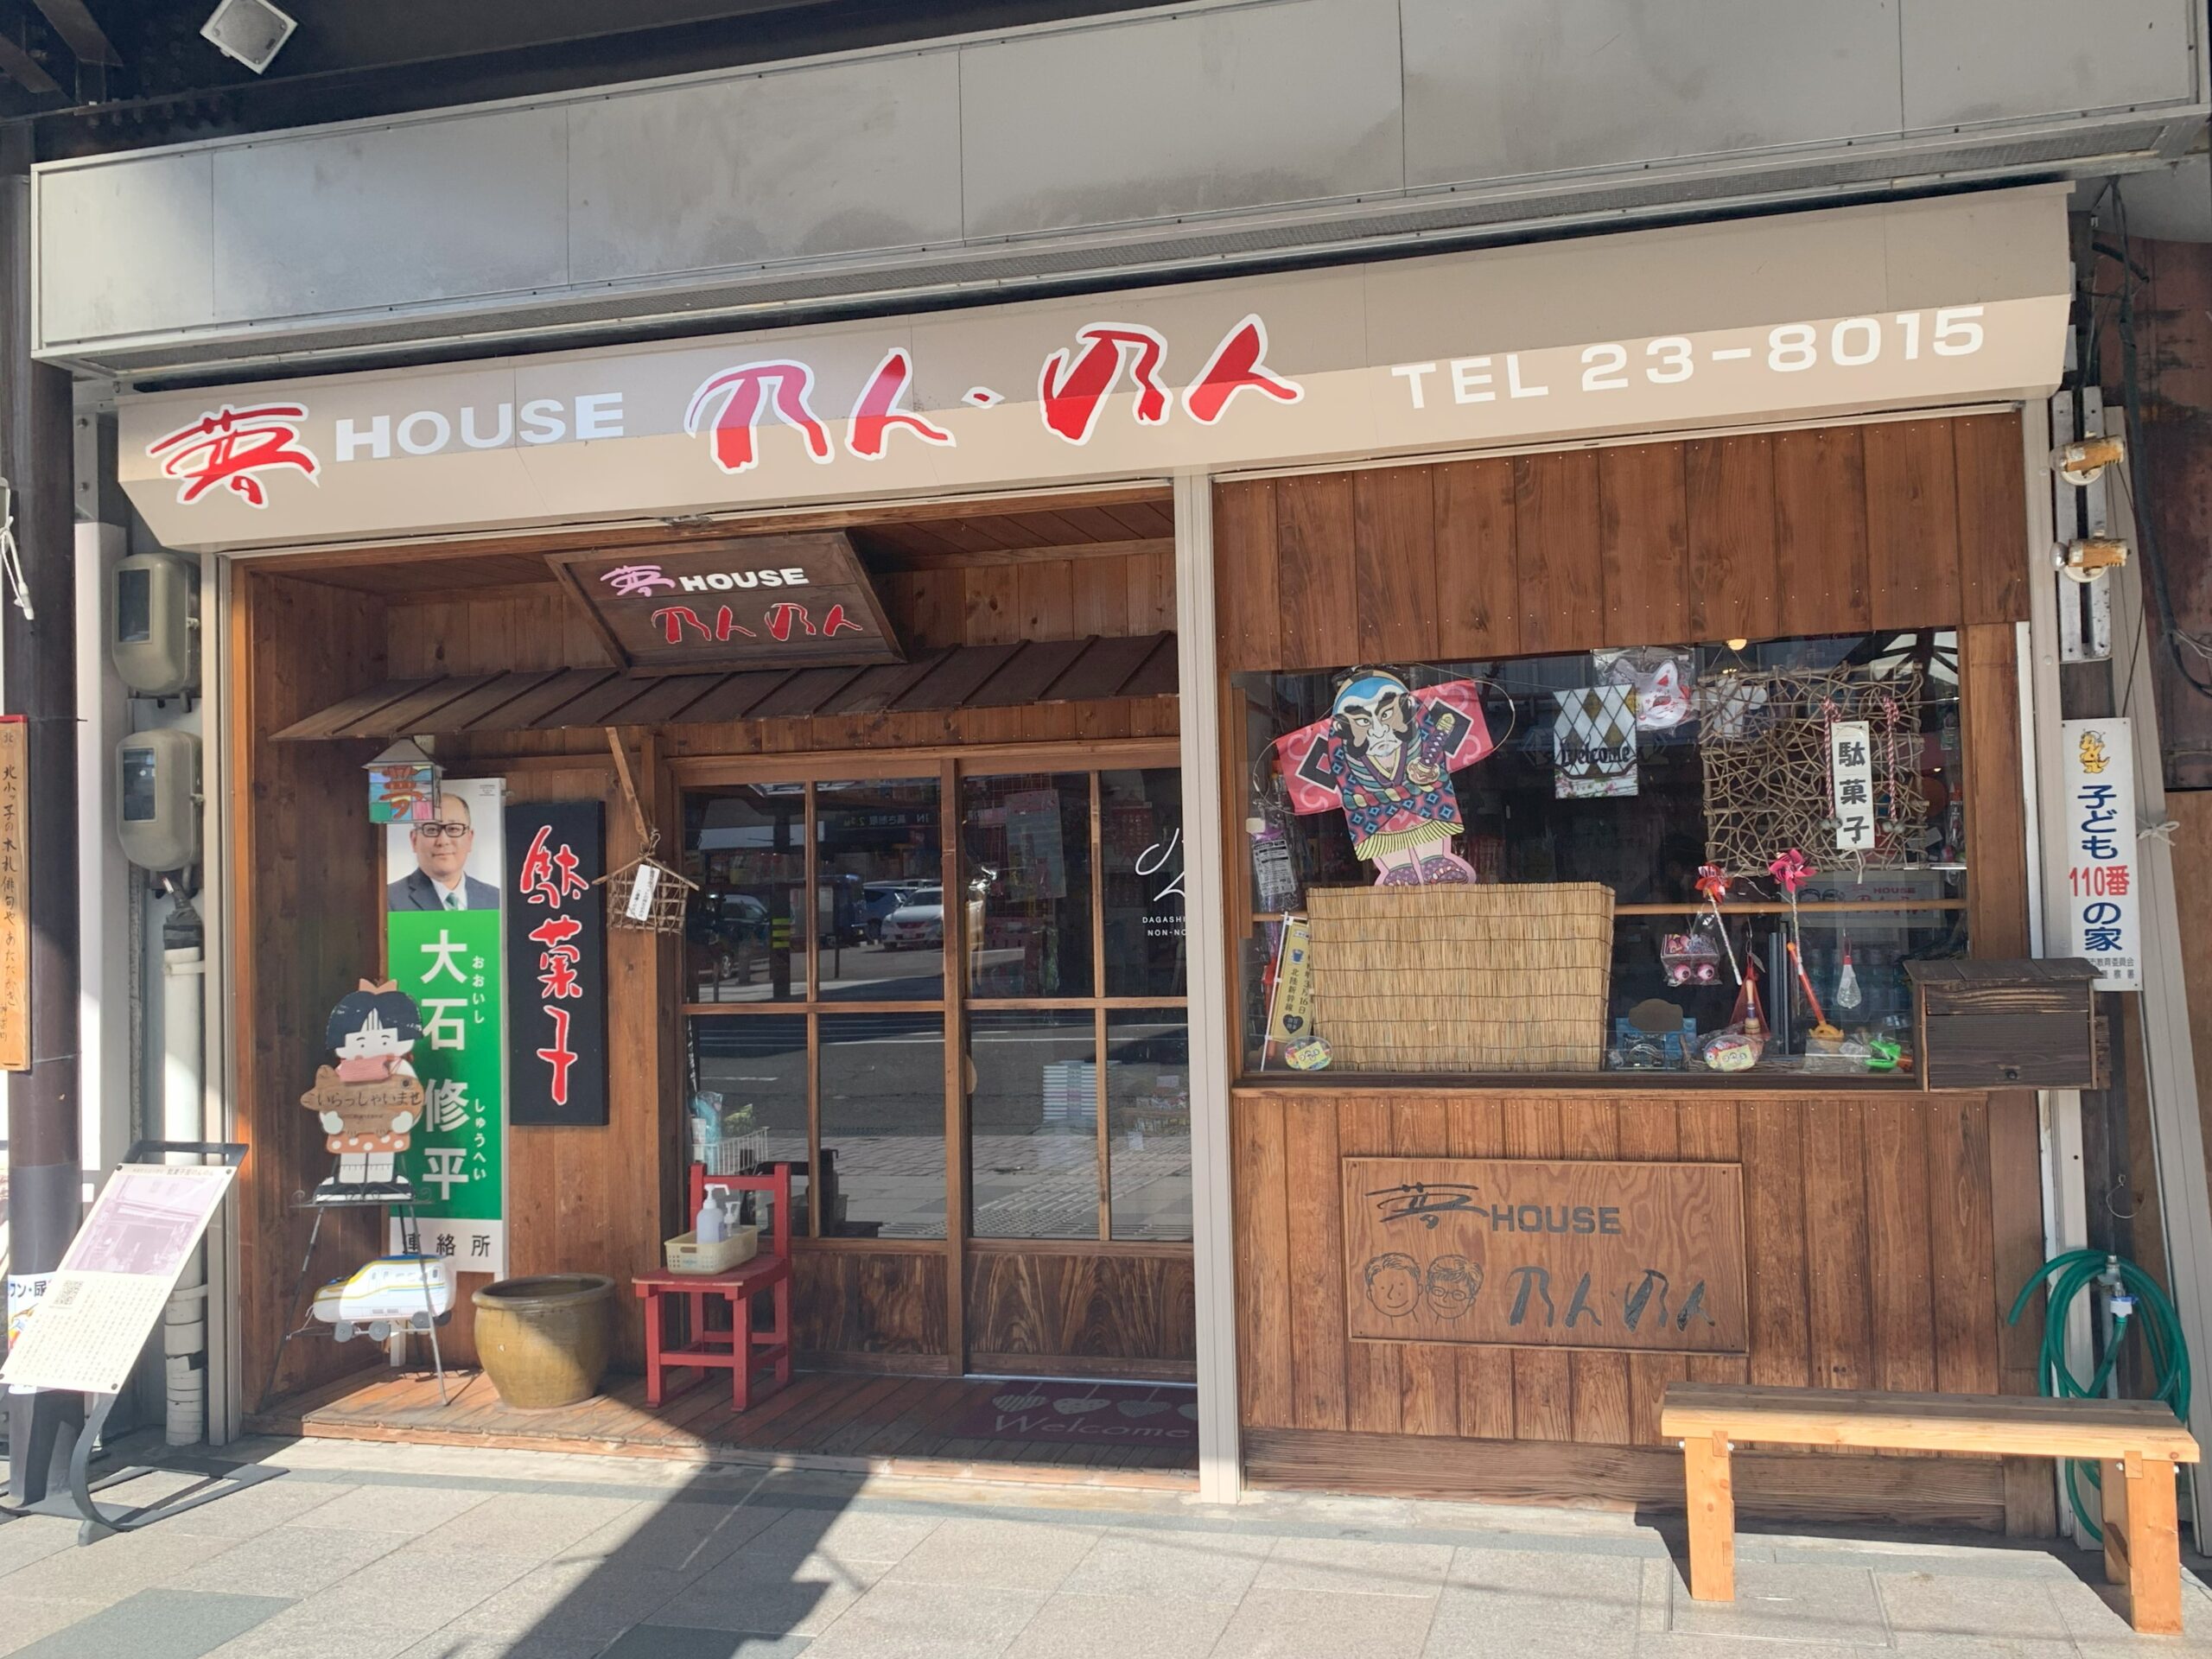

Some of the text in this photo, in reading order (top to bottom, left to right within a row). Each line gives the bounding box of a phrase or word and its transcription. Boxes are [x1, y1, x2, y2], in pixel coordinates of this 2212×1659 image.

[334, 391, 625, 462] HOUSE
[1391, 355, 1549, 410] TEL
[1580, 305, 1985, 392] 23-8015
[679, 568, 810, 592] HOUSE
[1838, 741, 1870, 844] 駄菓子
[420, 929, 470, 1201] 大石 修平
[472, 956, 487, 1181] おおいし しゅうへい
[317, 1091, 423, 1107] いらっしゃいませ
[1491, 1204, 1622, 1236] HOUSE
[995, 1414, 1192, 1438] Welcome
